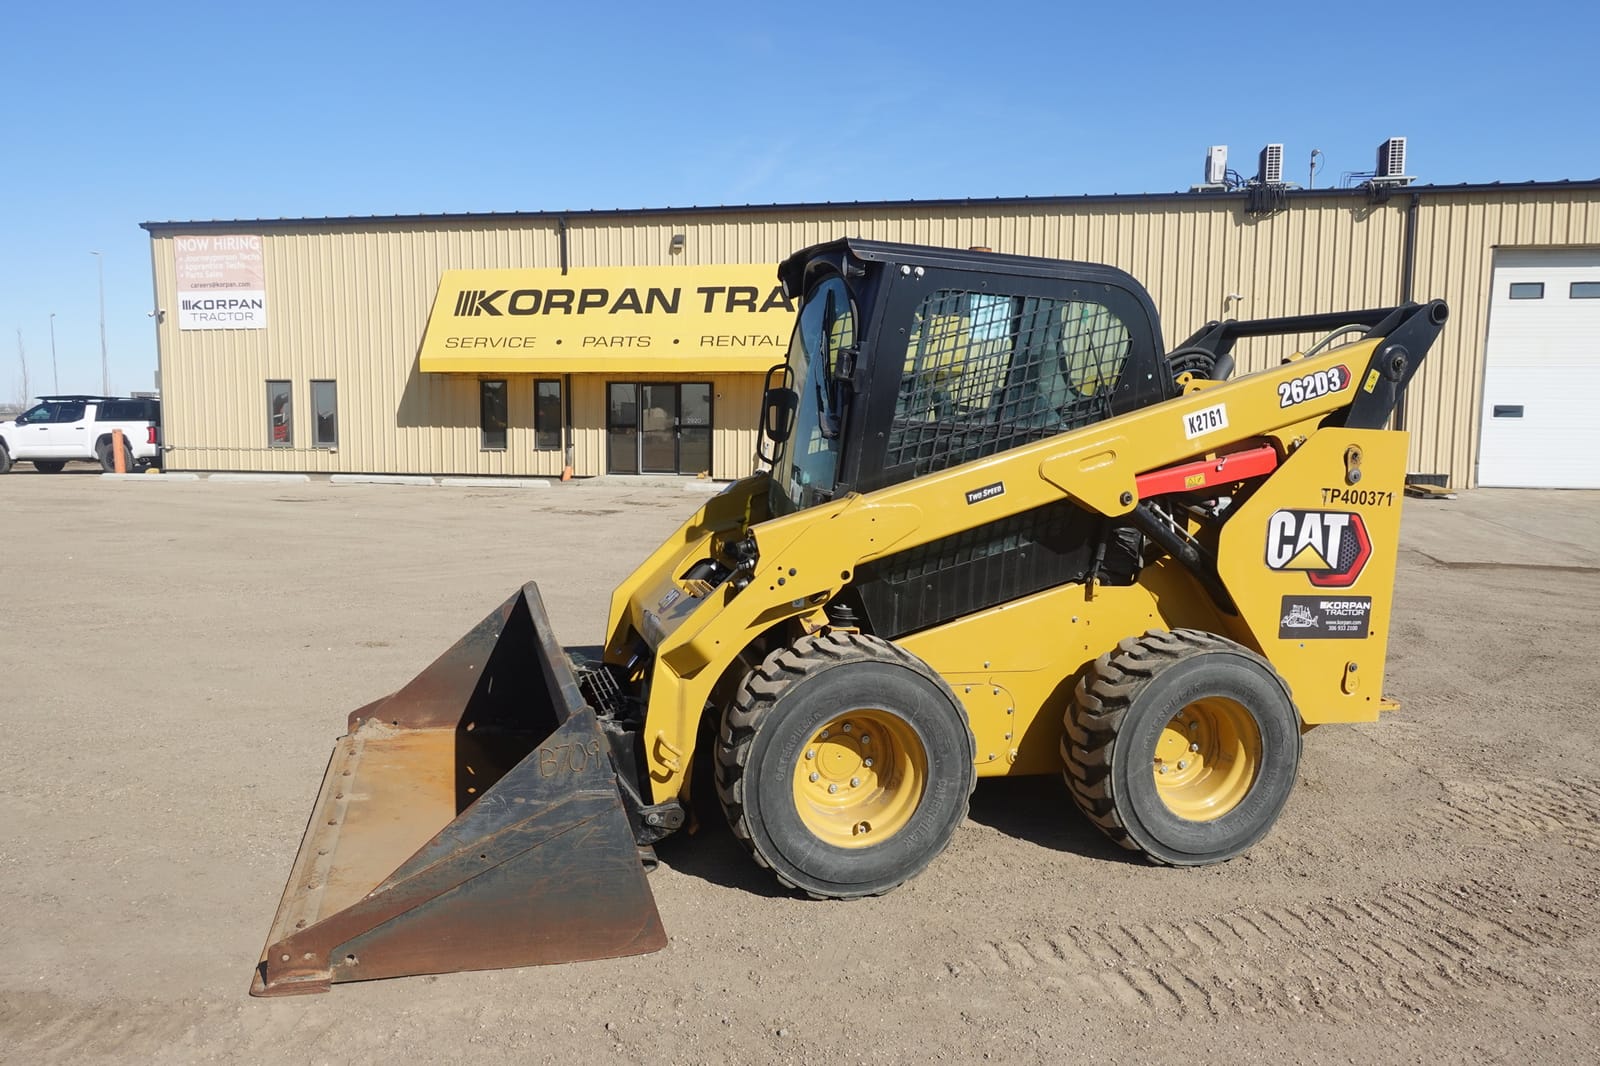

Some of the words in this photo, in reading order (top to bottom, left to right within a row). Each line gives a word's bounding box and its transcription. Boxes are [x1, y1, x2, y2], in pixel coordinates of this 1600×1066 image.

[177, 238, 209, 252] NOW
[214, 237, 260, 251] HIRING
[190, 281, 251, 289] careers@korpan.com
[182, 298, 263, 311] KORPAN
[453, 287, 681, 317] KORPAN
[697, 286, 798, 313] TRA
[190, 311, 254, 321] TRACTOR
[445, 336, 537, 349] SERVICE
[582, 336, 651, 348] PARTS
[700, 335, 787, 347] RENTAL
[1279, 367, 1341, 407] 262D3
[1188, 408, 1223, 435] K2761
[1321, 488, 1393, 507] TP400371
[1267, 511, 1350, 569] CAT
[1320, 601, 1371, 610] KORPAN
[774, 710, 824, 782] CATERPILLAR
[540, 739, 600, 777] B709
[903, 778, 949, 848] CATERPILLAR
